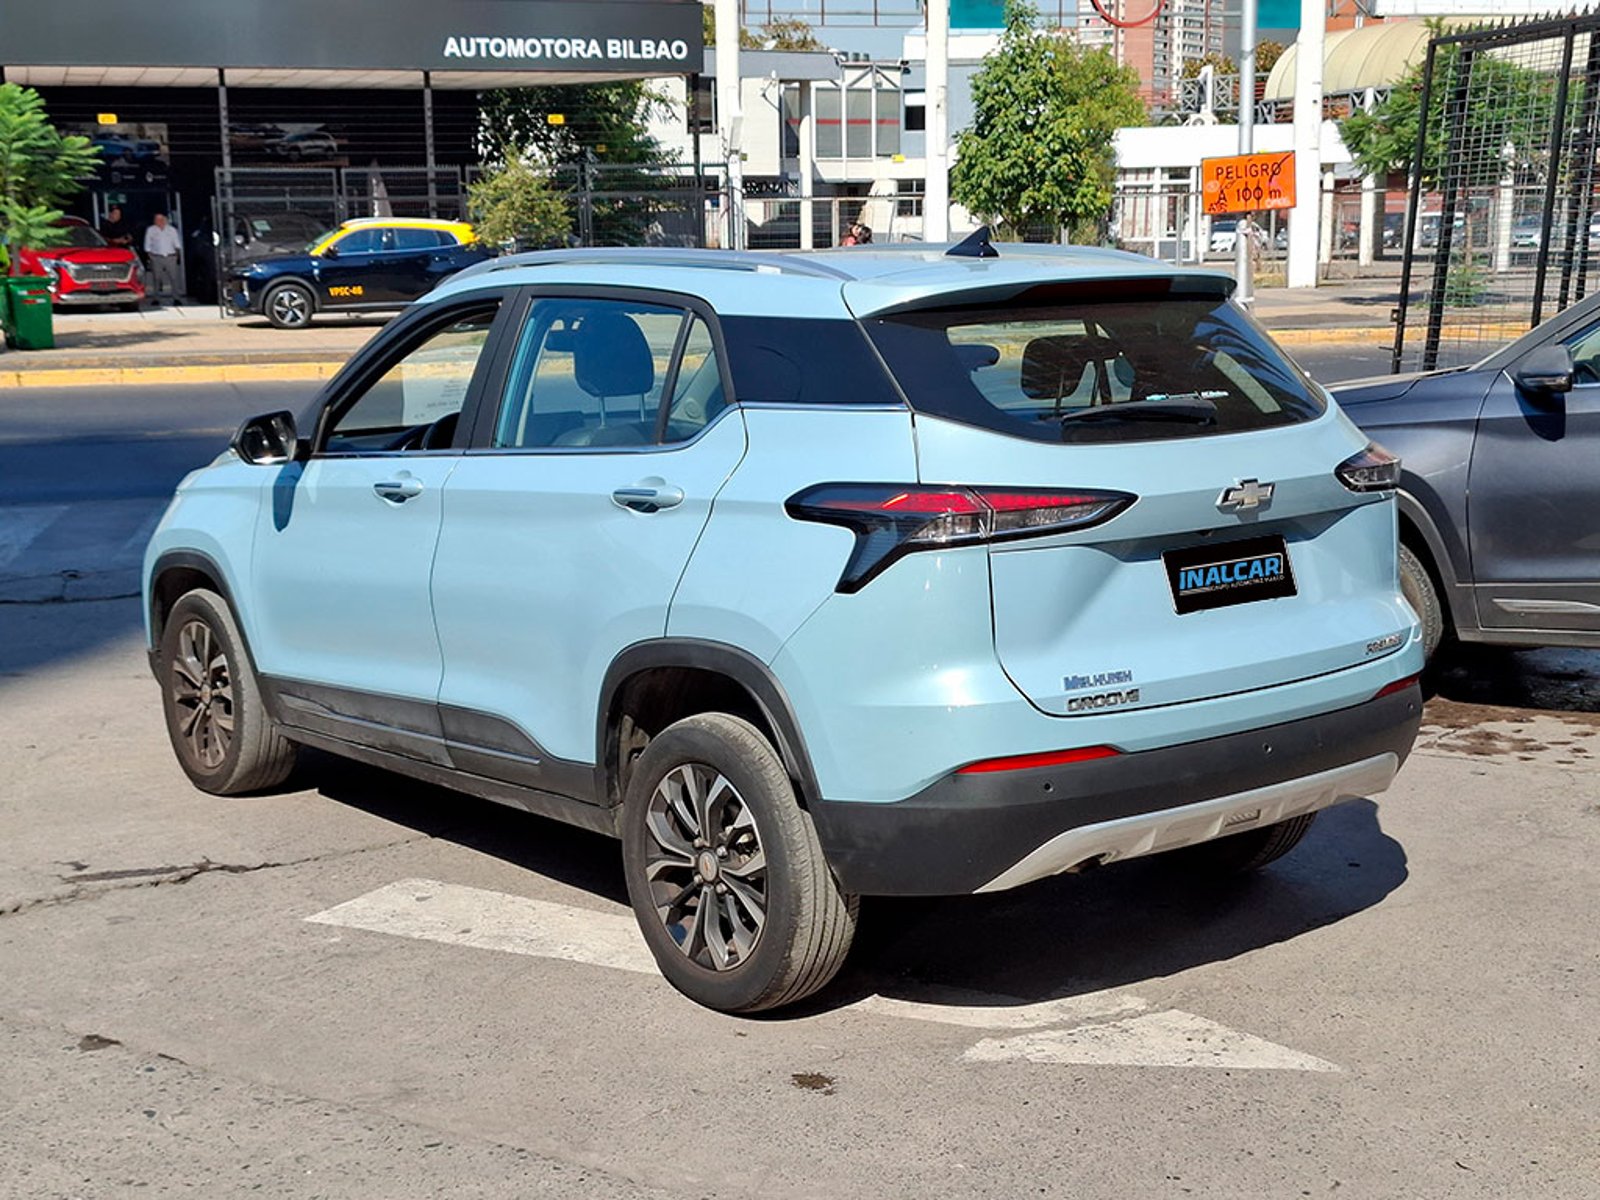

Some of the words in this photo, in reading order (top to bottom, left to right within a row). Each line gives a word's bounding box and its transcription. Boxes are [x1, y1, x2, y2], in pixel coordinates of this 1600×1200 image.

[444, 37, 603, 59] AUTOMOTORA
[606, 38, 688, 60] BILBAO
[1215, 161, 1281, 181] PELIGRO
[1236, 185, 1263, 202] 100
[1179, 557, 1281, 590] INALCAR
